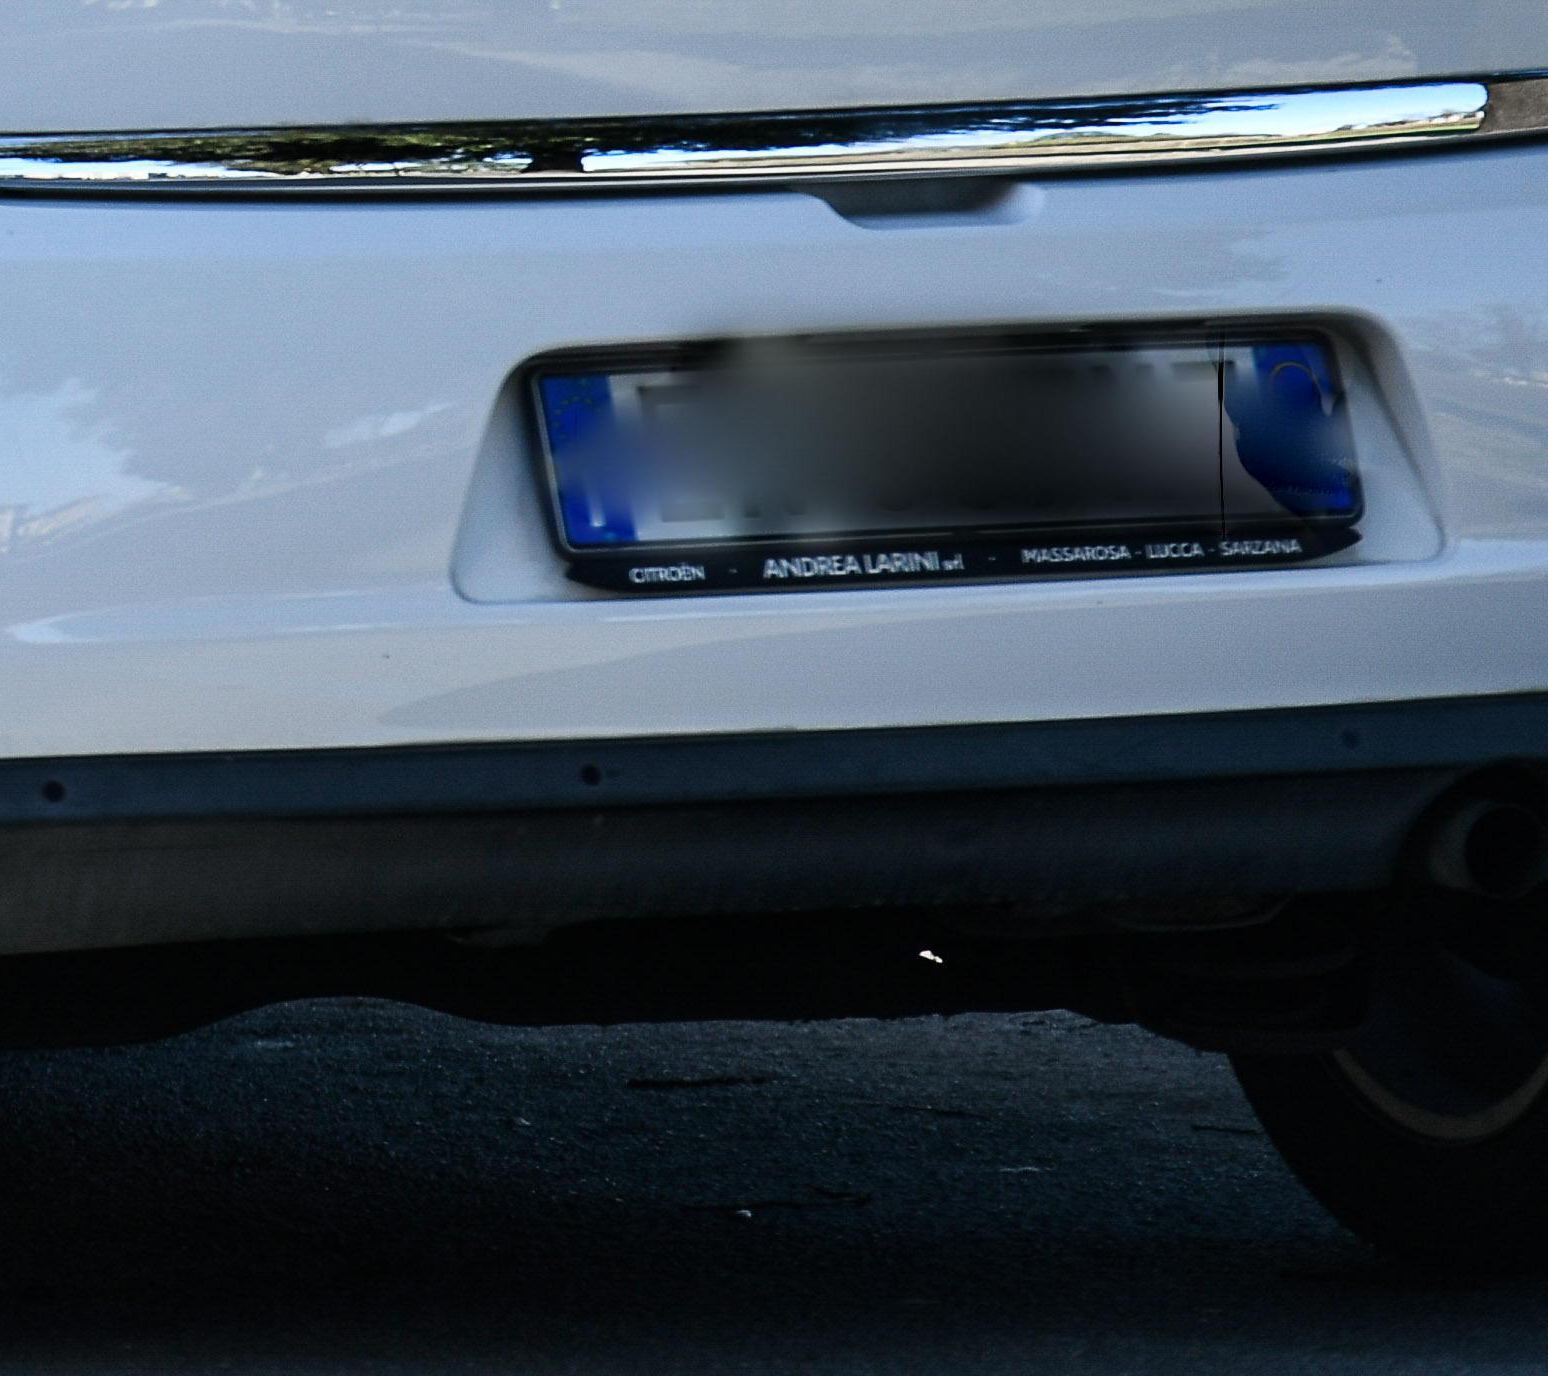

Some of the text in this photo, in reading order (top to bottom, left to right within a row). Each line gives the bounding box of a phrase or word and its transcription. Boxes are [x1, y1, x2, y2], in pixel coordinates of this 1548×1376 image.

[762, 553, 862, 580] ANDREA
[863, 550, 942, 575] LARINI
[1020, 545, 1132, 564] MASSAROSA
[1144, 542, 1205, 560] LUCCA
